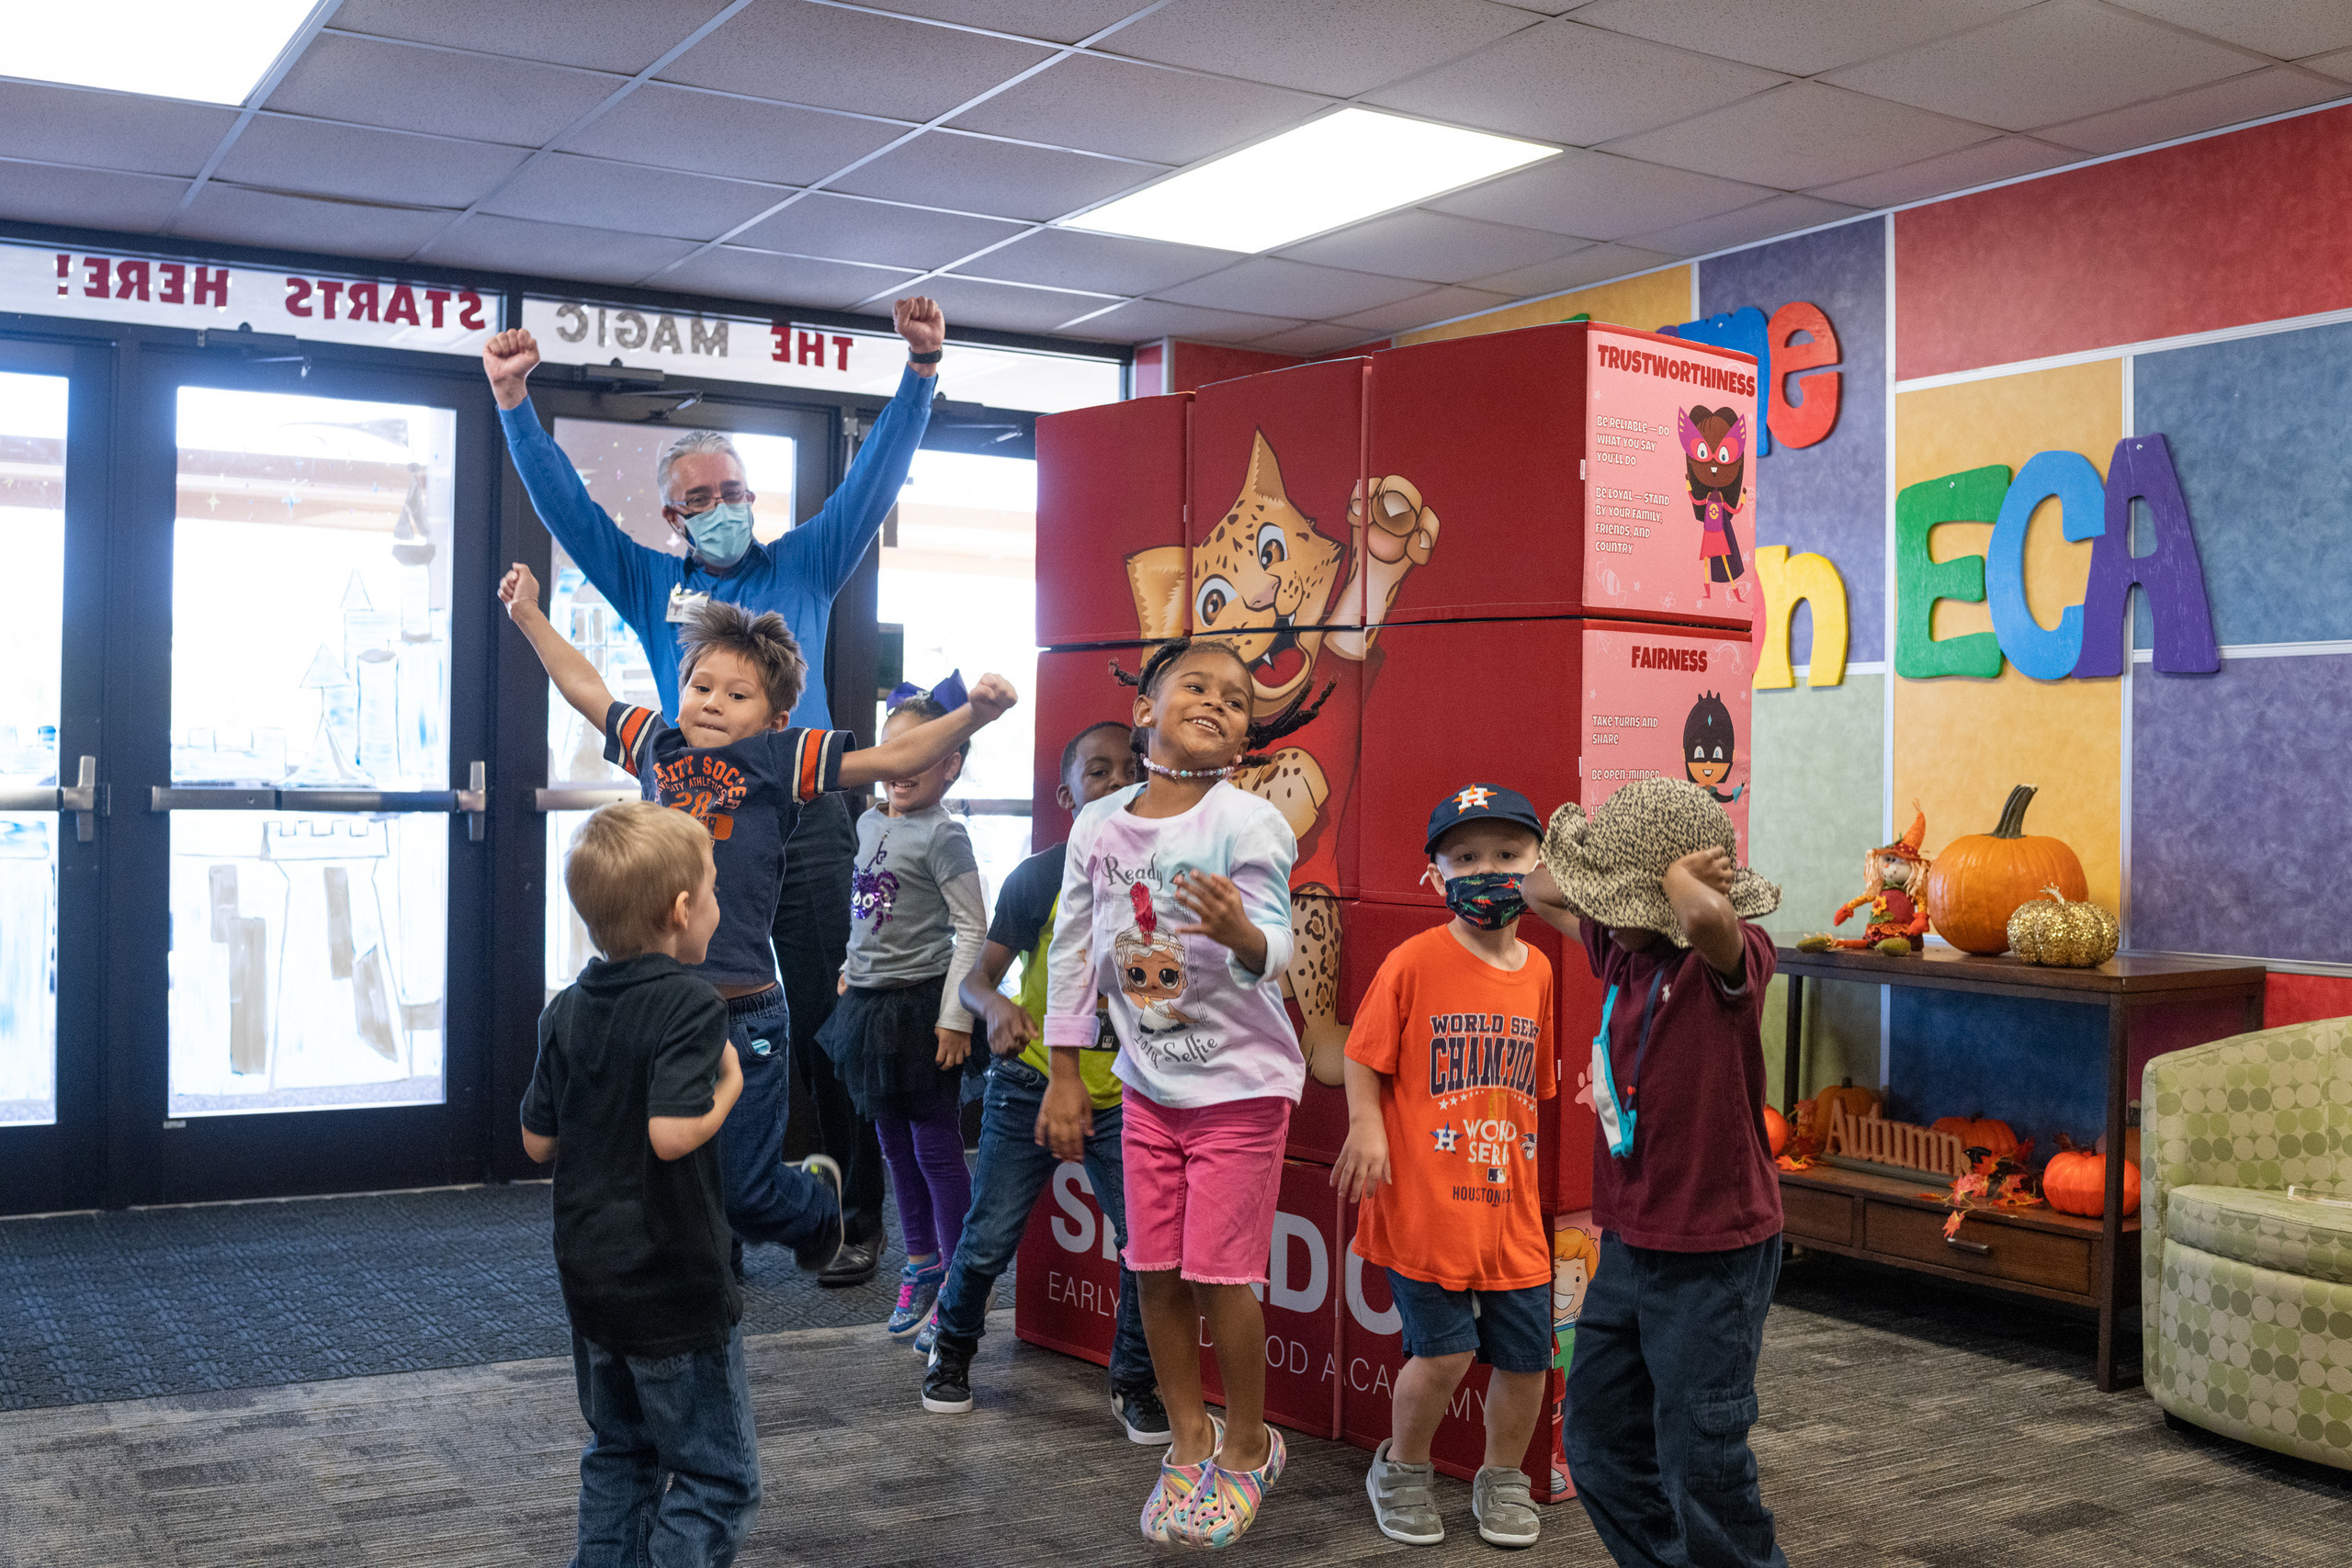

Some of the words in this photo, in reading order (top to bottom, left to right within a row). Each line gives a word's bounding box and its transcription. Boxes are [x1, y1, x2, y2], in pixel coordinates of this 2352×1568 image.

[1598, 344, 1756, 397] TRUSTWORTHINESS
[1658, 425, 1669, 436] DO
[1597, 434, 1622, 446] WHAT
[1623, 436, 1639, 450] YOU
[1641, 439, 1657, 452] SAY
[1596, 451, 1623, 465] YOU'LL
[1625, 455, 1636, 466] DO
[1608, 488, 1634, 502] LOYAL
[1644, 492, 1670, 506] STAND
[1595, 504, 1607, 516] BY
[1608, 506, 1631, 519] YOUR
[1634, 526, 1651, 538] AND
[1595, 541, 1634, 555] COUNTRY
[1895, 432, 2221, 680] ECA
[1631, 646, 1708, 672] FAIRNESS
[1592, 715, 1613, 727] TAKE
[1614, 716, 1640, 728] TURNS
[1641, 716, 1658, 728] AND
[1592, 733, 1619, 745] SHARE
[1102, 852, 1163, 892] Ready
[1430, 1013, 1504, 1036] WORLD
[1163, 1033, 1217, 1064] Selfie
[1430, 1035, 1536, 1100] CHAMPIO
[1825, 1097, 1962, 1176] Autumn
[1453, 1186, 1500, 1204] HOUSTON
[1048, 1270, 1120, 1319] EARLY
